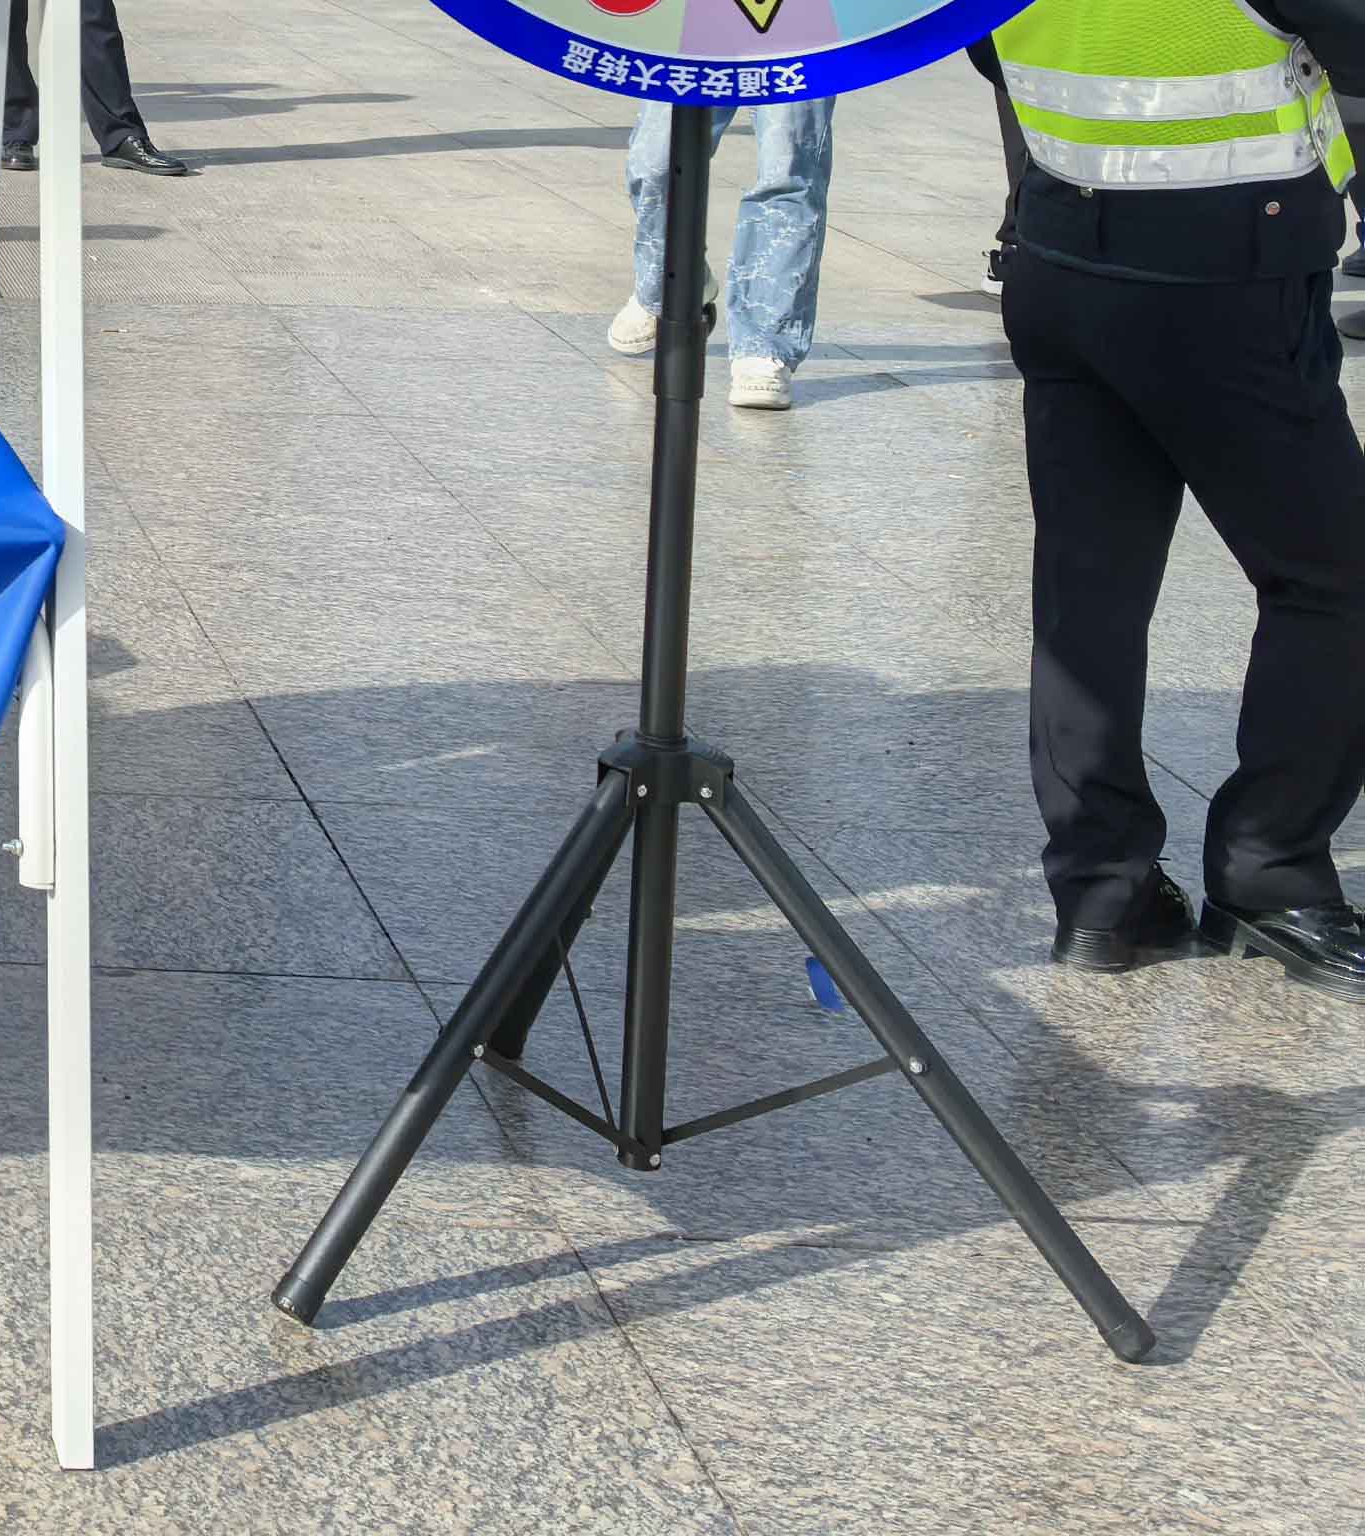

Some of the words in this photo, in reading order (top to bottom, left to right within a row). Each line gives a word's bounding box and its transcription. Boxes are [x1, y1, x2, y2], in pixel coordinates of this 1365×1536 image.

[560, 38, 806, 97] 交通安全大转盘
